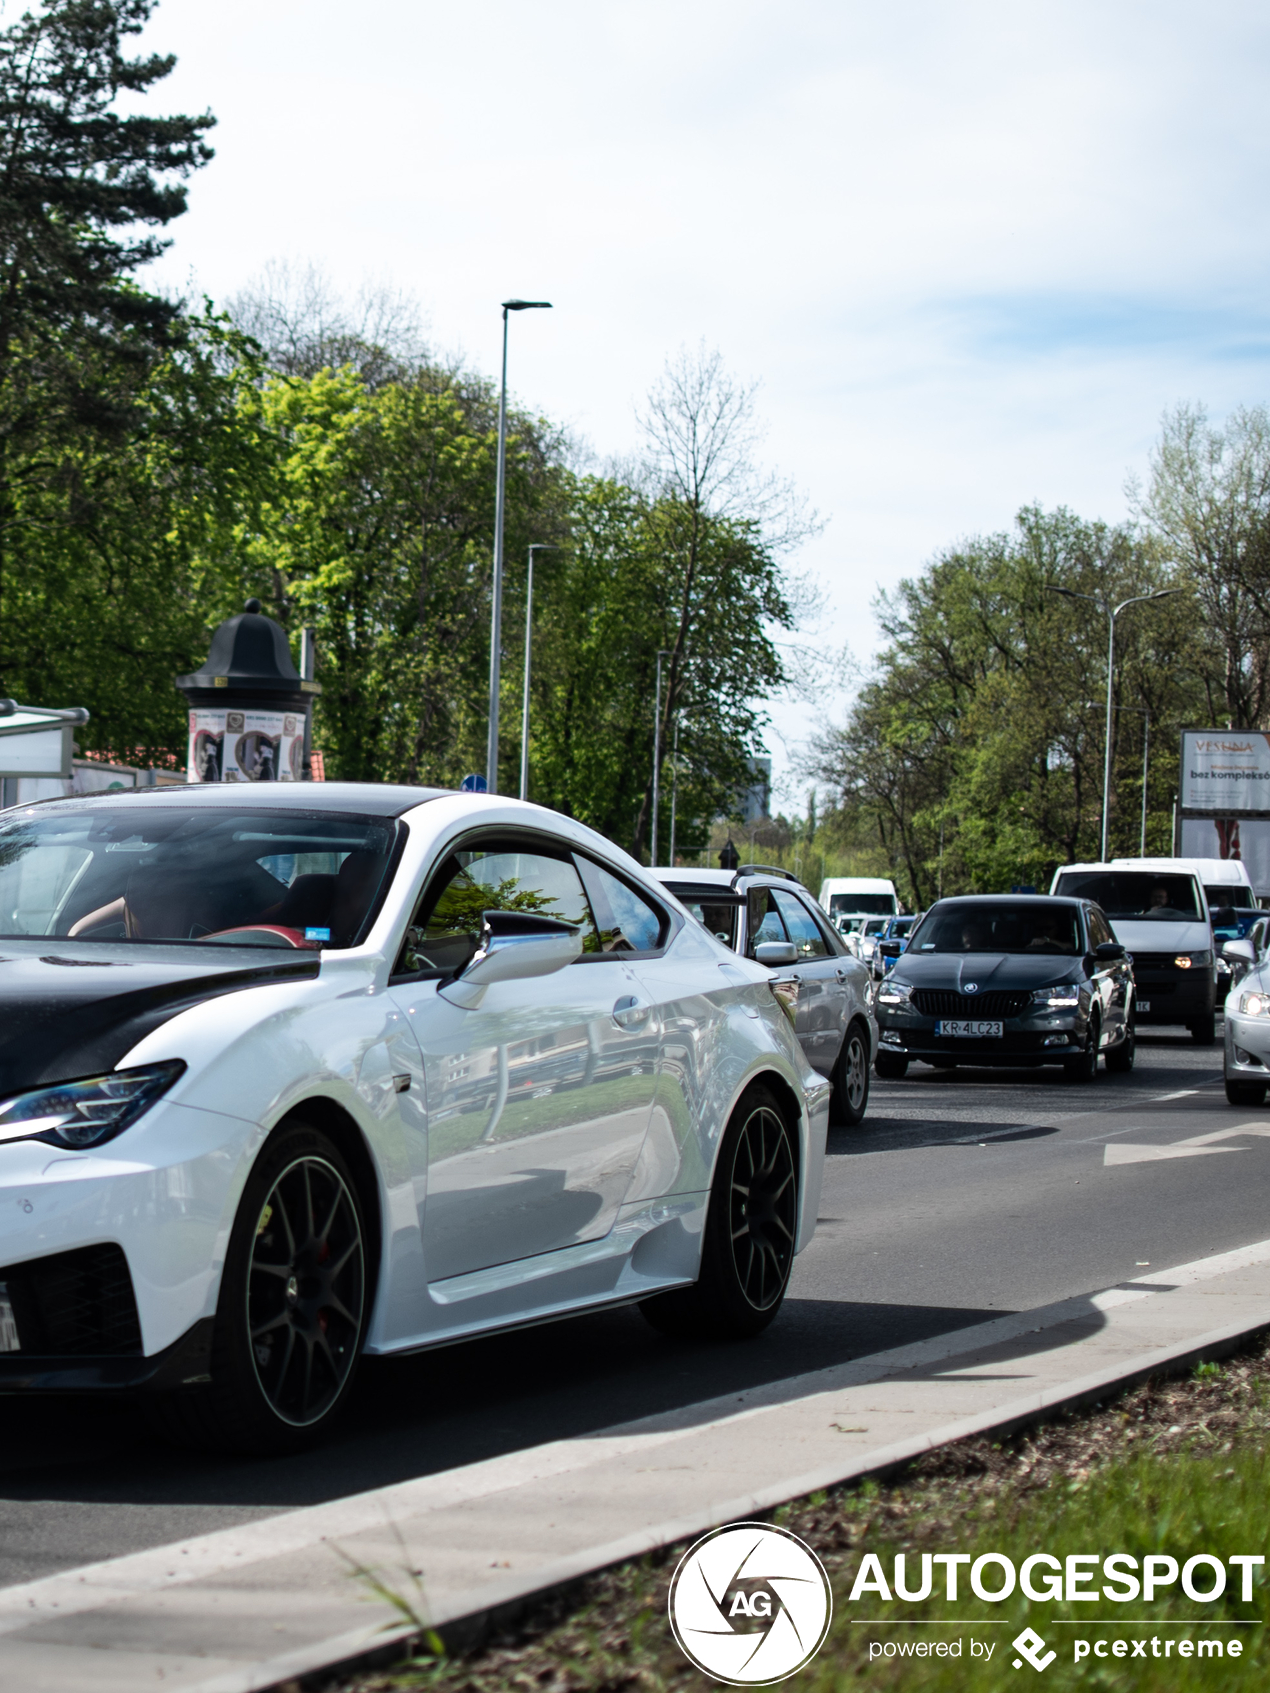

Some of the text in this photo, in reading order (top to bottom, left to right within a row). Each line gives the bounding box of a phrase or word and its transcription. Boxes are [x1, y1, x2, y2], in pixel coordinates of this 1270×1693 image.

[1196, 741, 1256, 752] VESUNA
[1190, 770, 1209, 779] bez
[942, 1022, 1001, 1034] KR 4LC23
